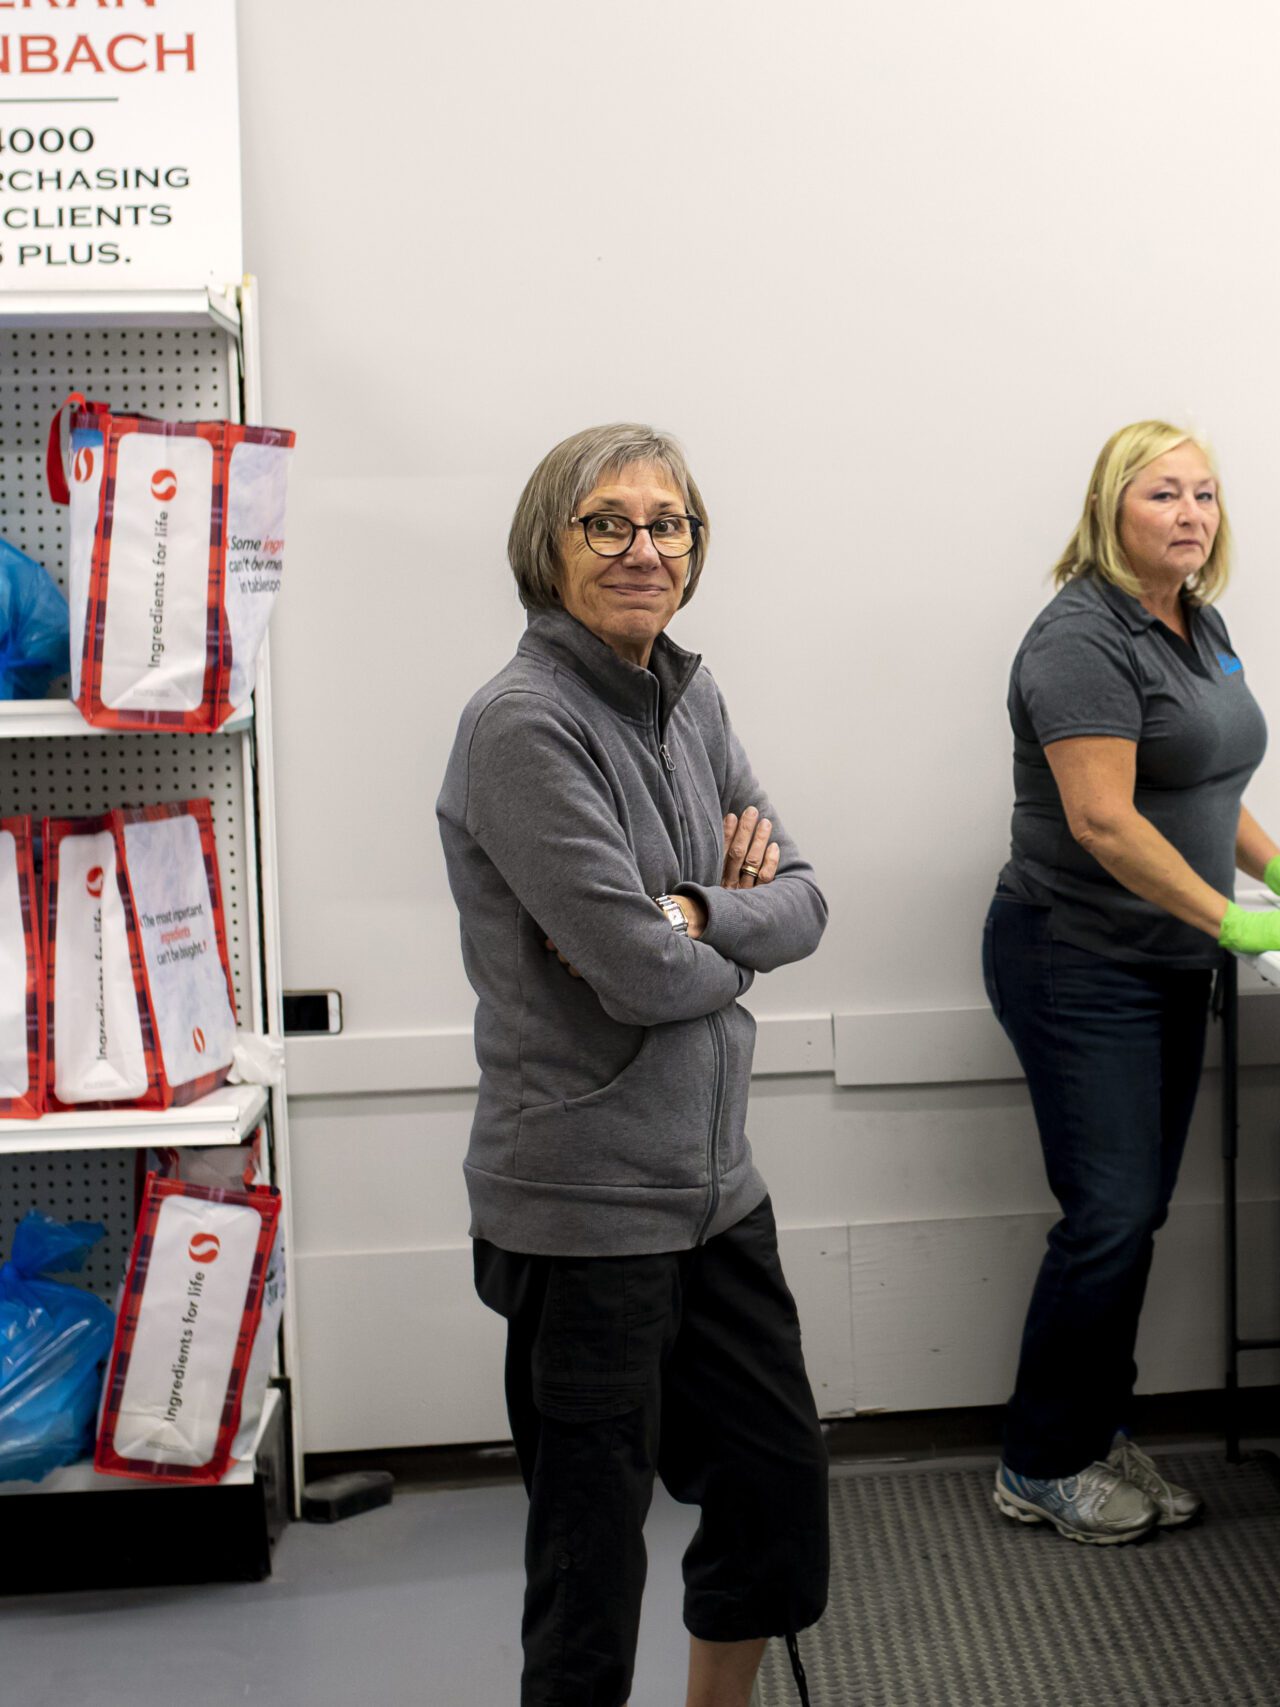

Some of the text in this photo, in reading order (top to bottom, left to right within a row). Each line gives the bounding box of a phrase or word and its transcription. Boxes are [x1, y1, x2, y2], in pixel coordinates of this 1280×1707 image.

[0, 127, 95, 153] 000
[0, 167, 190, 192] CHASING
[3, 204, 173, 229] CLIENTS
[18, 243, 131, 266] PLUS.
[231, 535, 261, 551] Some
[147, 511, 169, 668] Ingredients for life
[164, 1270, 205, 1423] Ingredients for life
